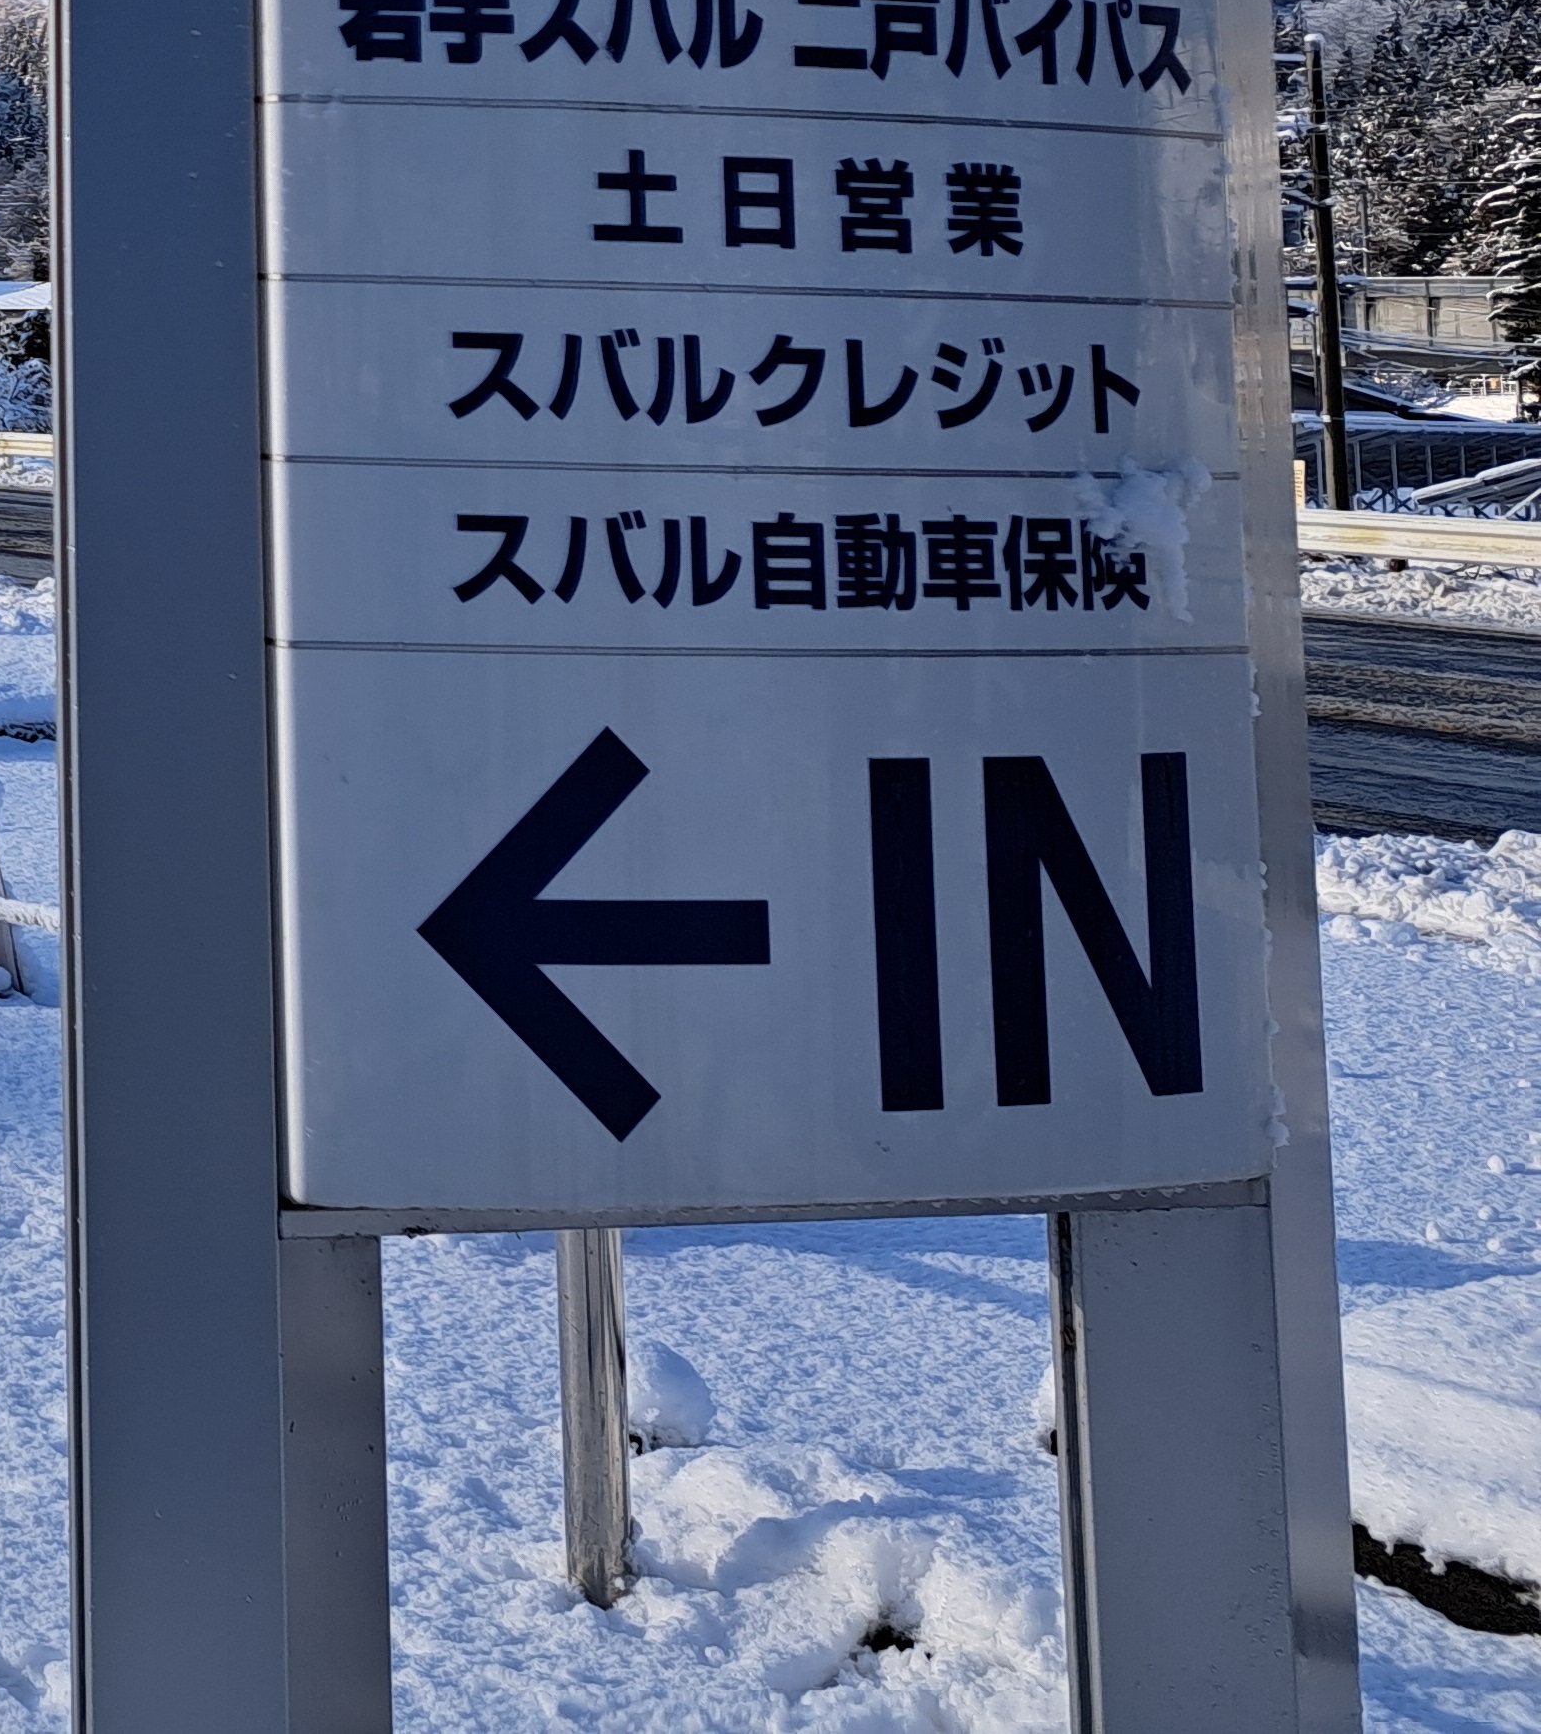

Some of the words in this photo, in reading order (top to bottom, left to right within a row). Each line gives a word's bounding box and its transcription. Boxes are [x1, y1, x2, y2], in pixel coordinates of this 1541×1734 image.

[592, 150, 1025, 258] 土日営業
[449, 327, 1141, 434] スバルクレジット
[453, 510, 1151, 612] スバル自動車保険
[868, 752, 1203, 1112] IN
